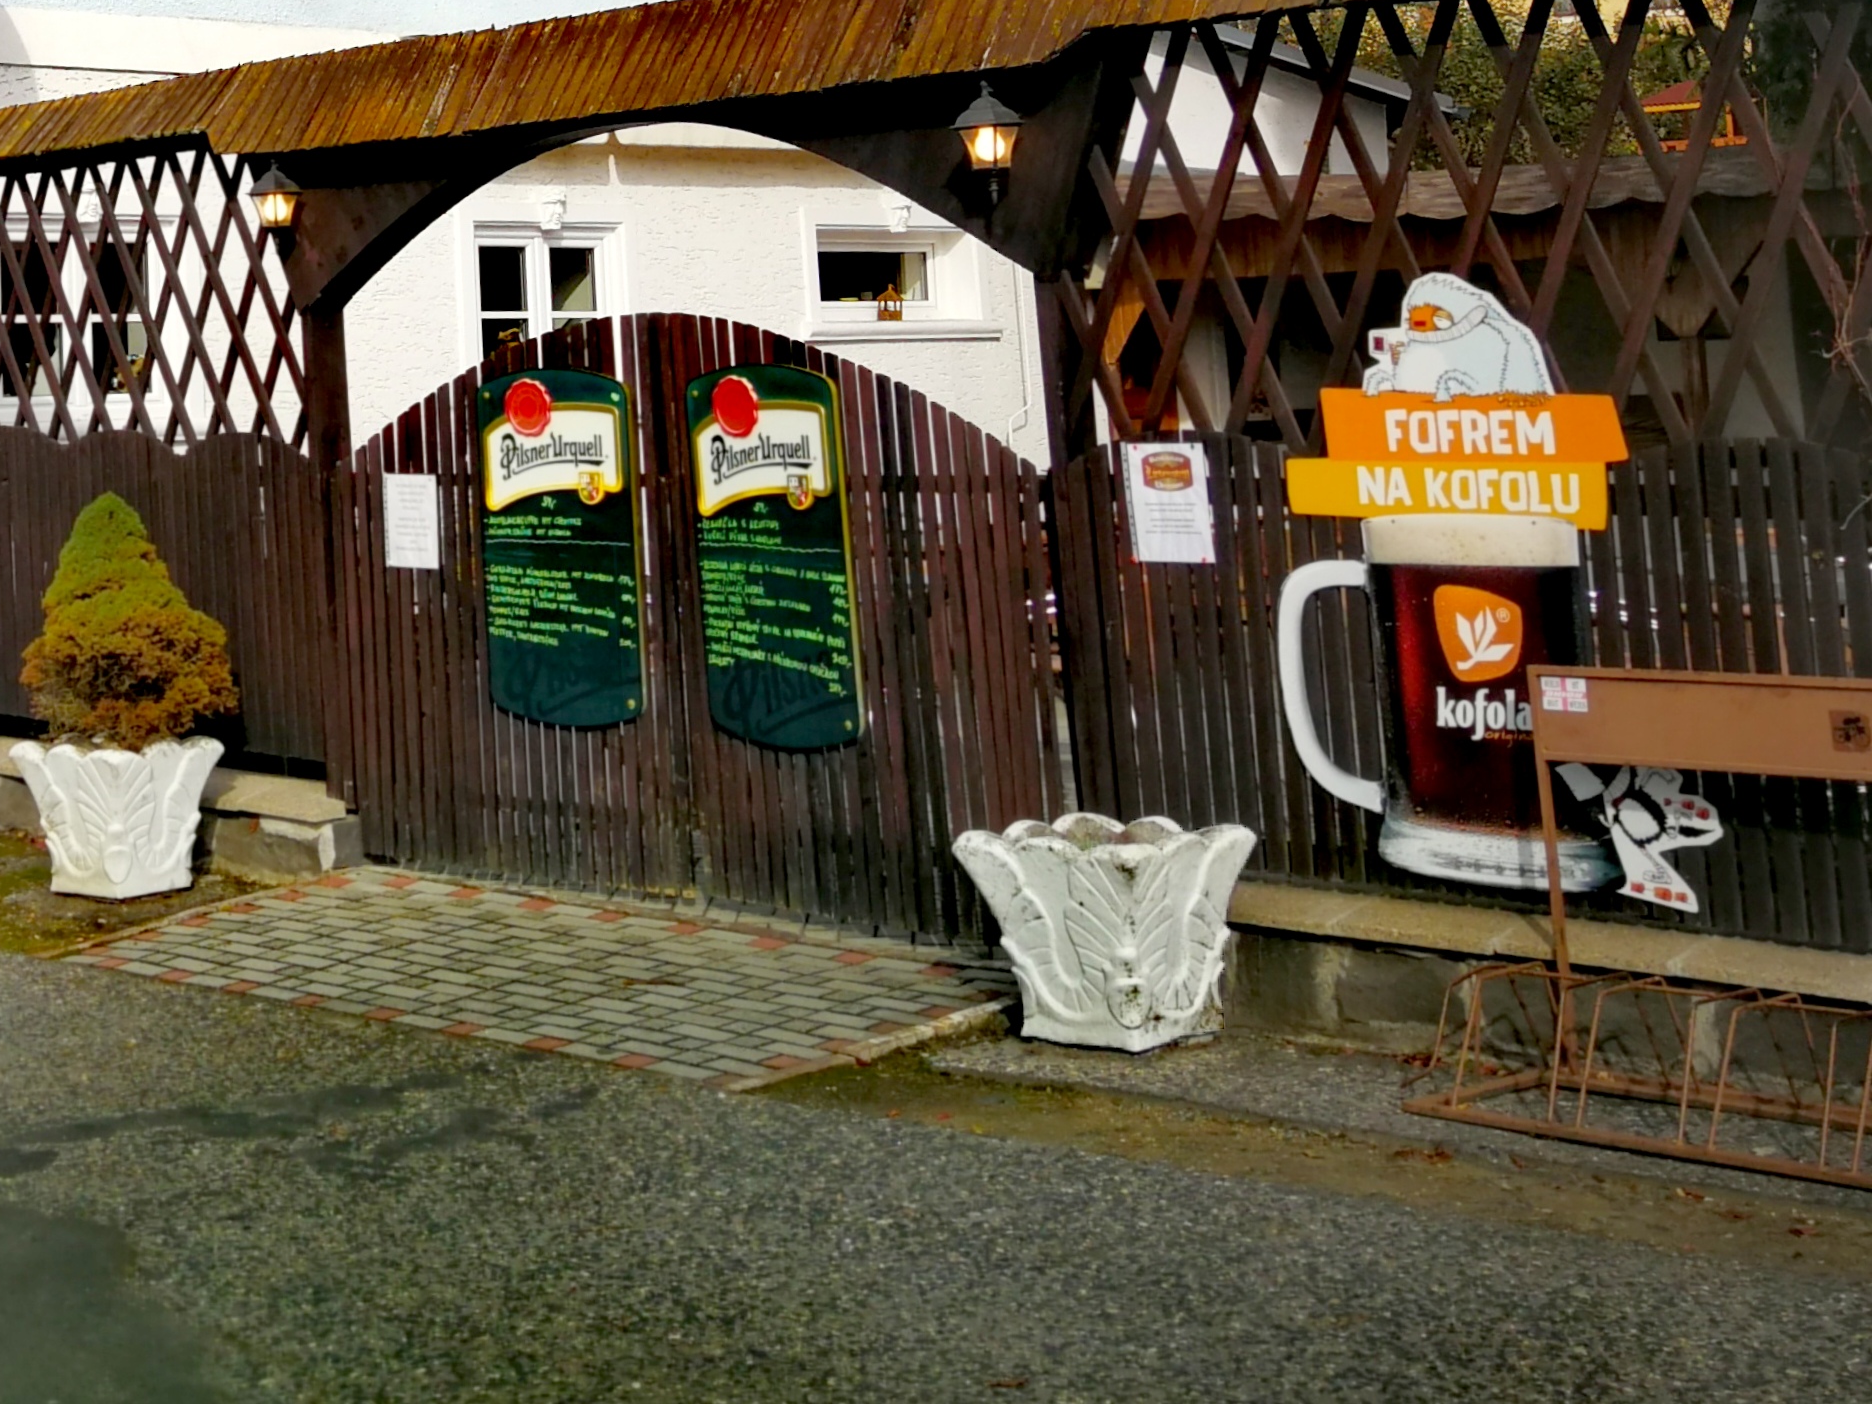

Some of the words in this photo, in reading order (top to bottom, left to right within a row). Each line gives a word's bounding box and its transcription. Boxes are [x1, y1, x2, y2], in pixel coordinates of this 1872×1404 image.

[500, 433, 552, 481] Pilsner
[550, 431, 603, 468] Urquell
[1384, 408, 1557, 456] FOFREM
[710, 434, 761, 486] Pilsner
[758, 432, 811, 471] Urquell
[1356, 465, 1414, 507] NA
[1423, 467, 1581, 514] KOFOLU
[1435, 686, 1534, 742] kofola
